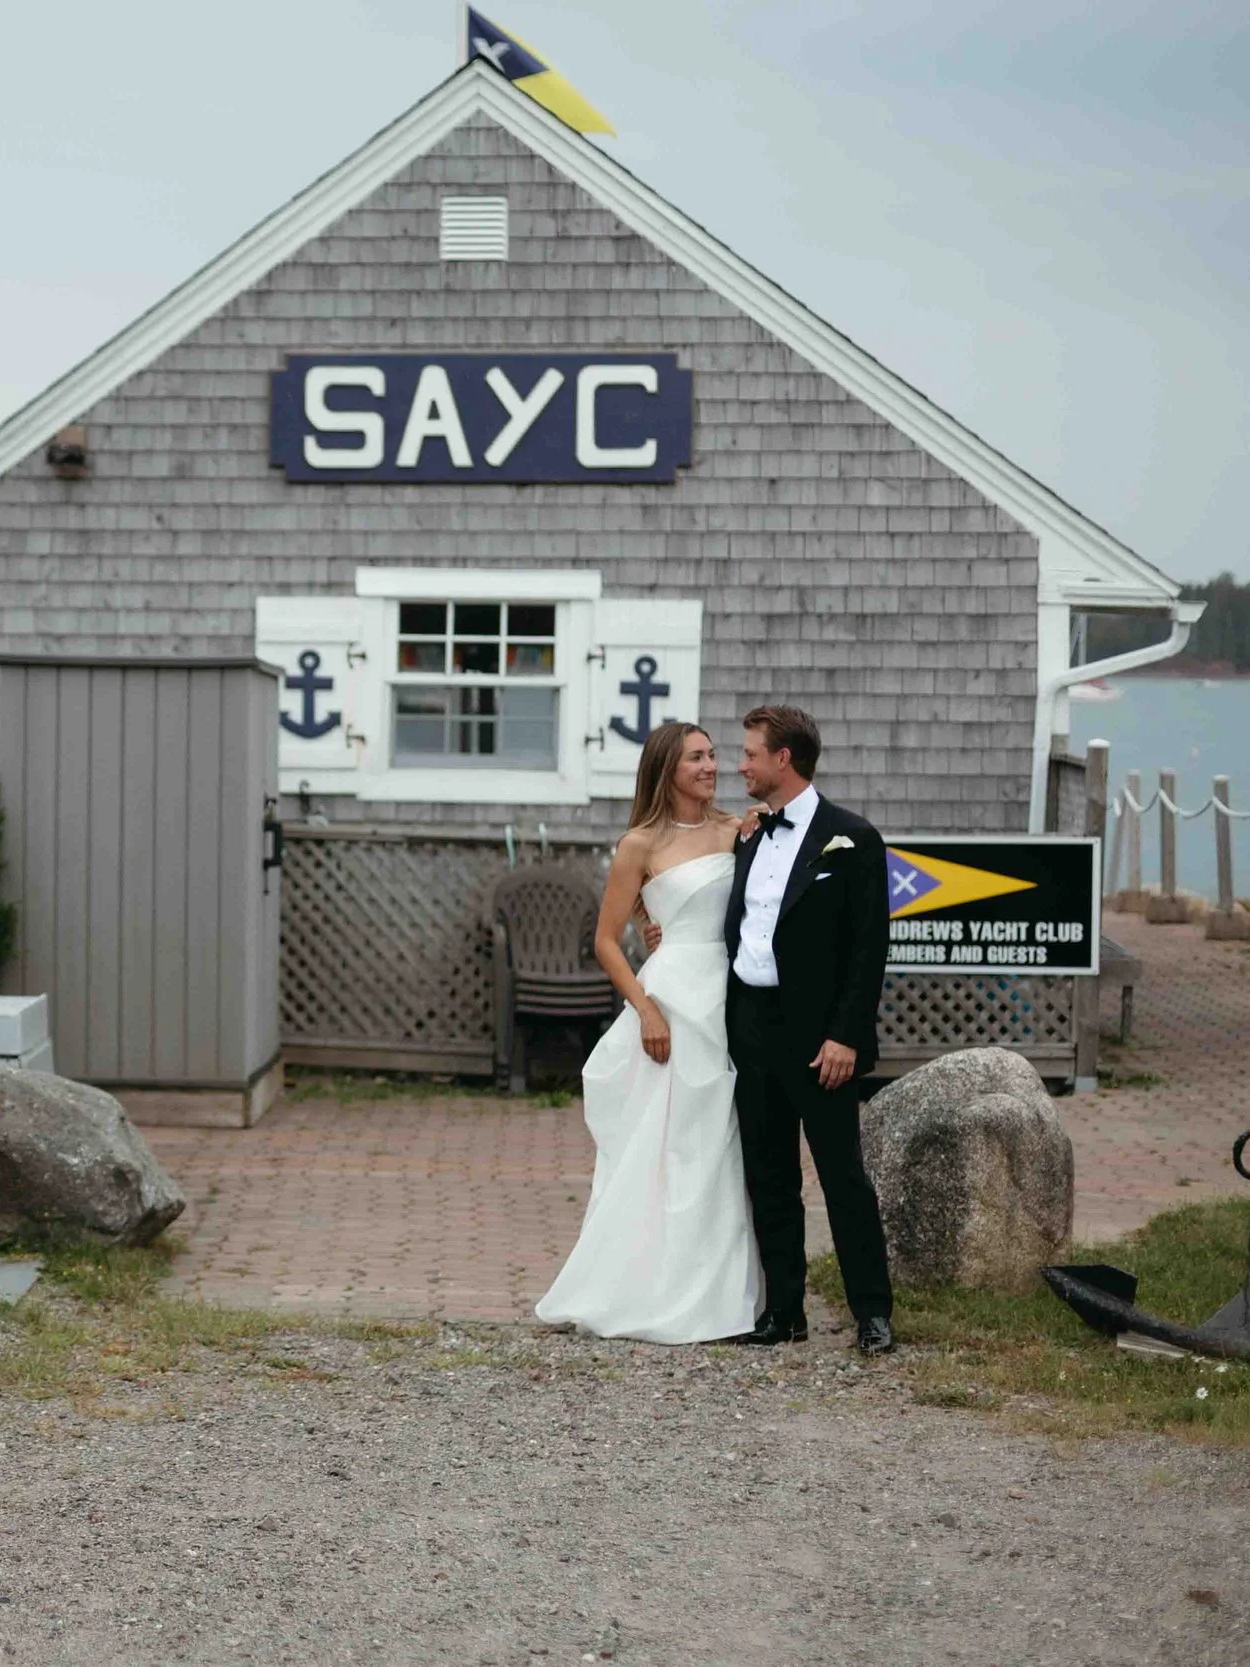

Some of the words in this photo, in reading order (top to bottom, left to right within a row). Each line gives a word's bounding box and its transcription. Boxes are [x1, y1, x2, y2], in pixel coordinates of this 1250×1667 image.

[303, 364, 658, 469] SAYC
[969, 920, 1029, 942] YACHT
[1034, 921, 1084, 942] CLUB
[950, 945, 983, 963] AND
[986, 945, 1048, 964] GUESTS
